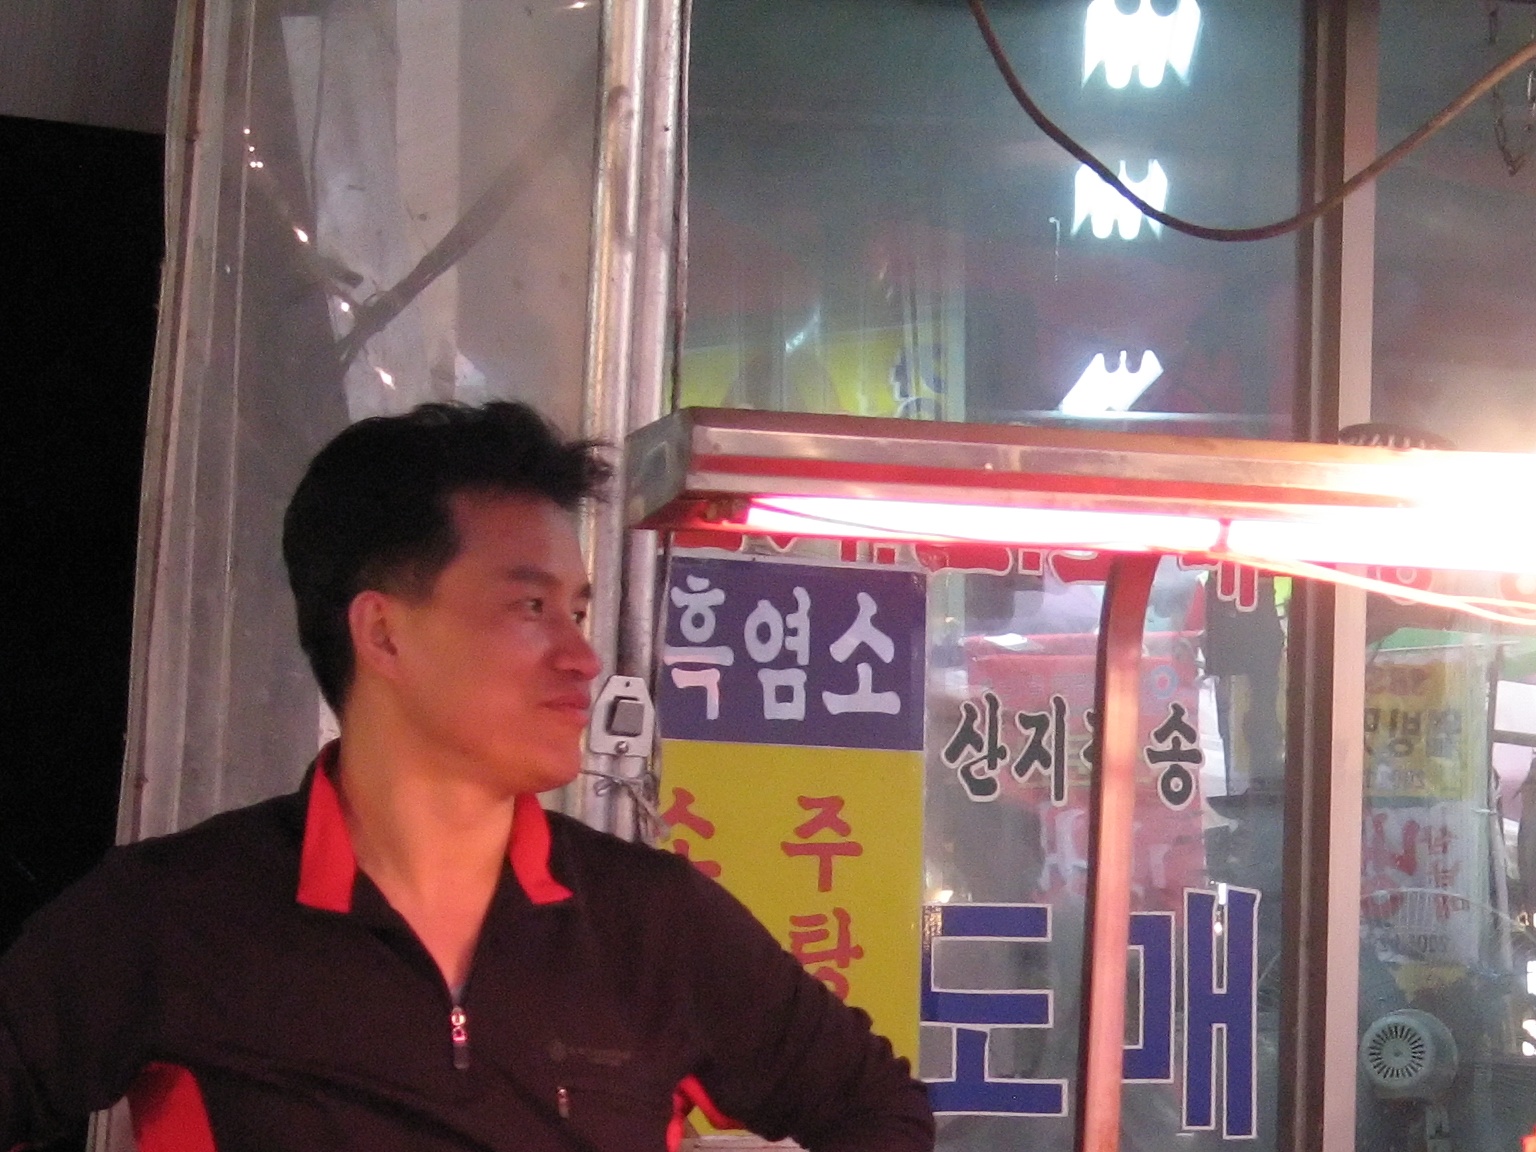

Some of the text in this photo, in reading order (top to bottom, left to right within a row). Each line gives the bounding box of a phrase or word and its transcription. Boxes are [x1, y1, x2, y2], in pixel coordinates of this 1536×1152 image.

[662, 575, 902, 721] 흑염소
[942, 691, 1206, 811] 산지송
[919, 887, 1261, 1140] 도매
